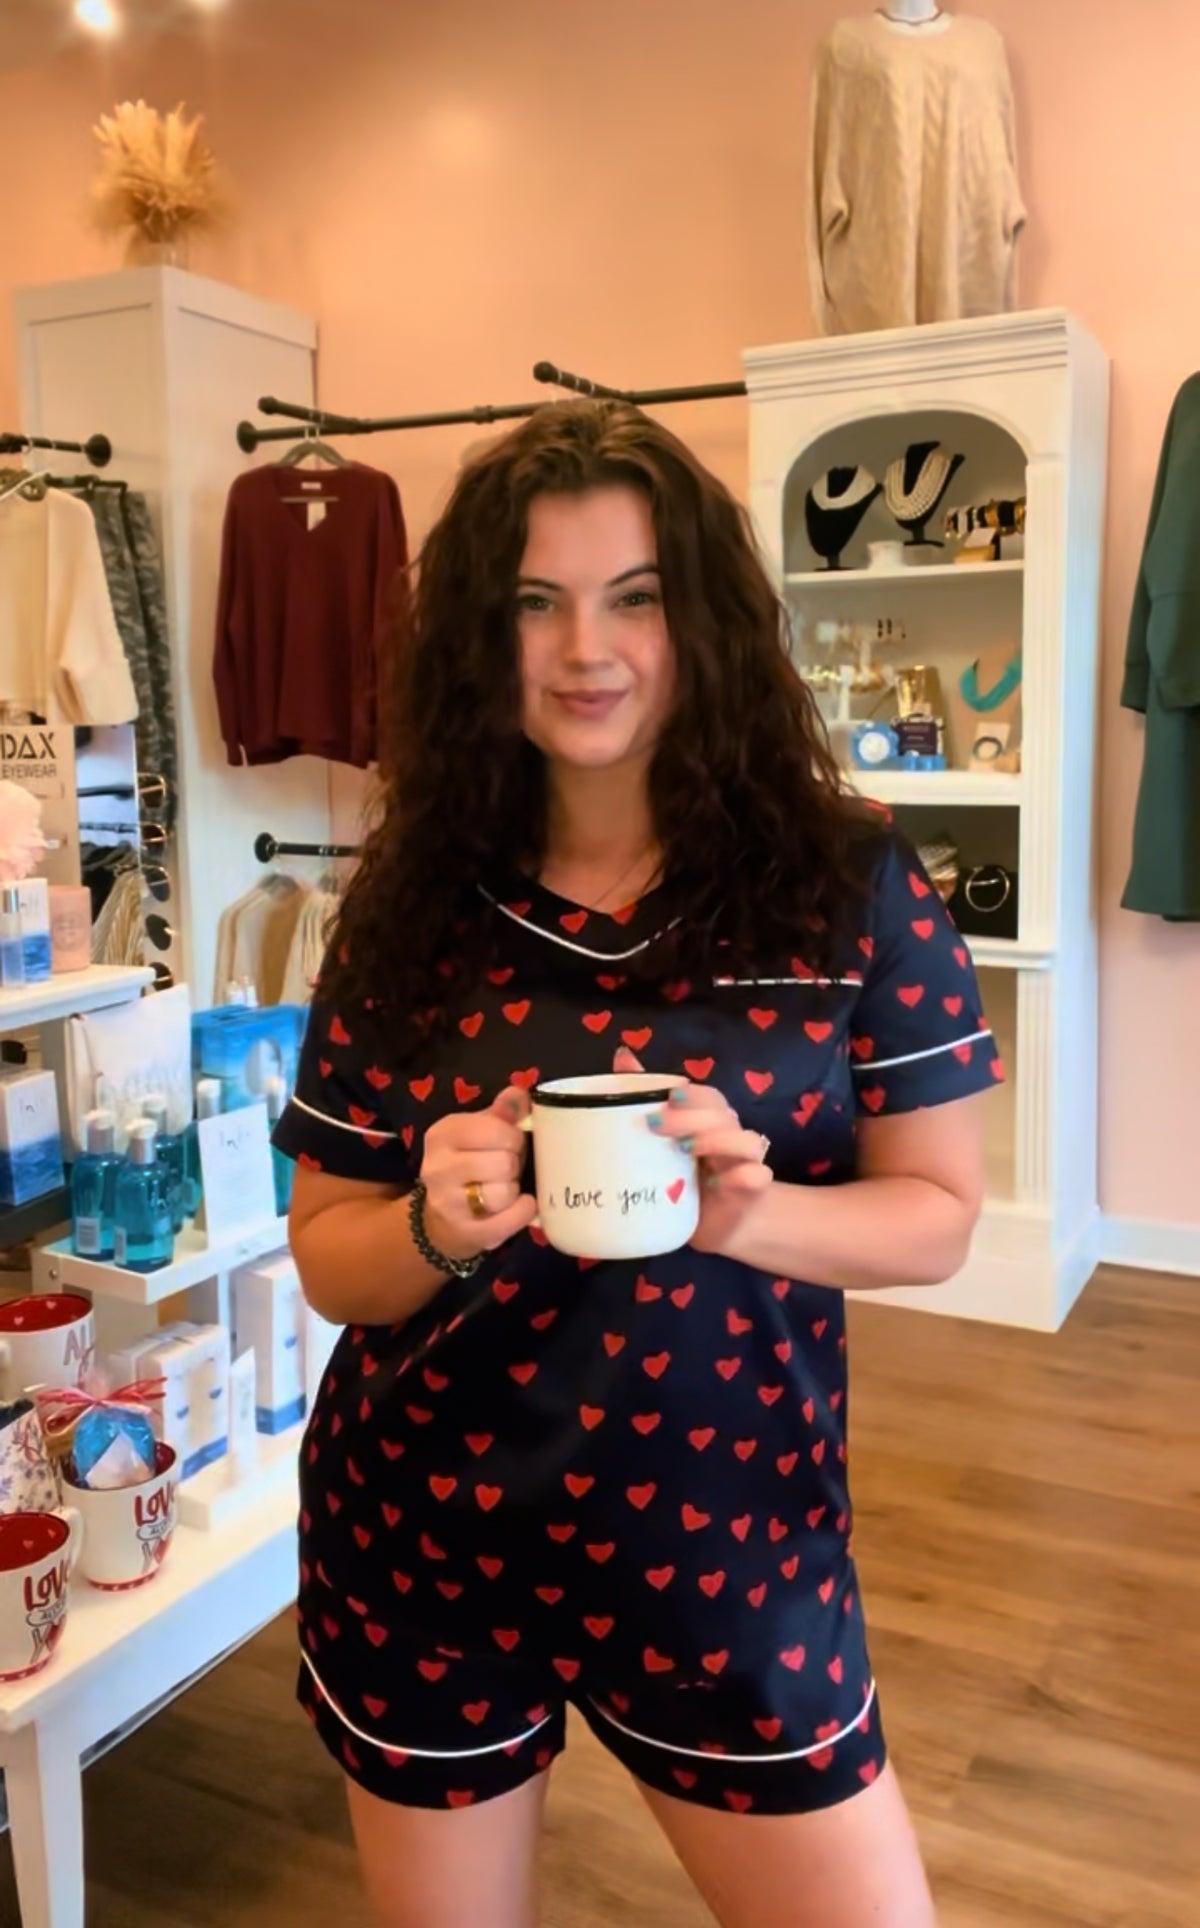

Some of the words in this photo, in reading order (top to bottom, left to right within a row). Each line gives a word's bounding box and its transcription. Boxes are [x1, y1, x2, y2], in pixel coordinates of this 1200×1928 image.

[2, 764, 57, 779] EYEWEAR
[564, 1186, 604, 1209] love
[616, 1186, 656, 1215] you
